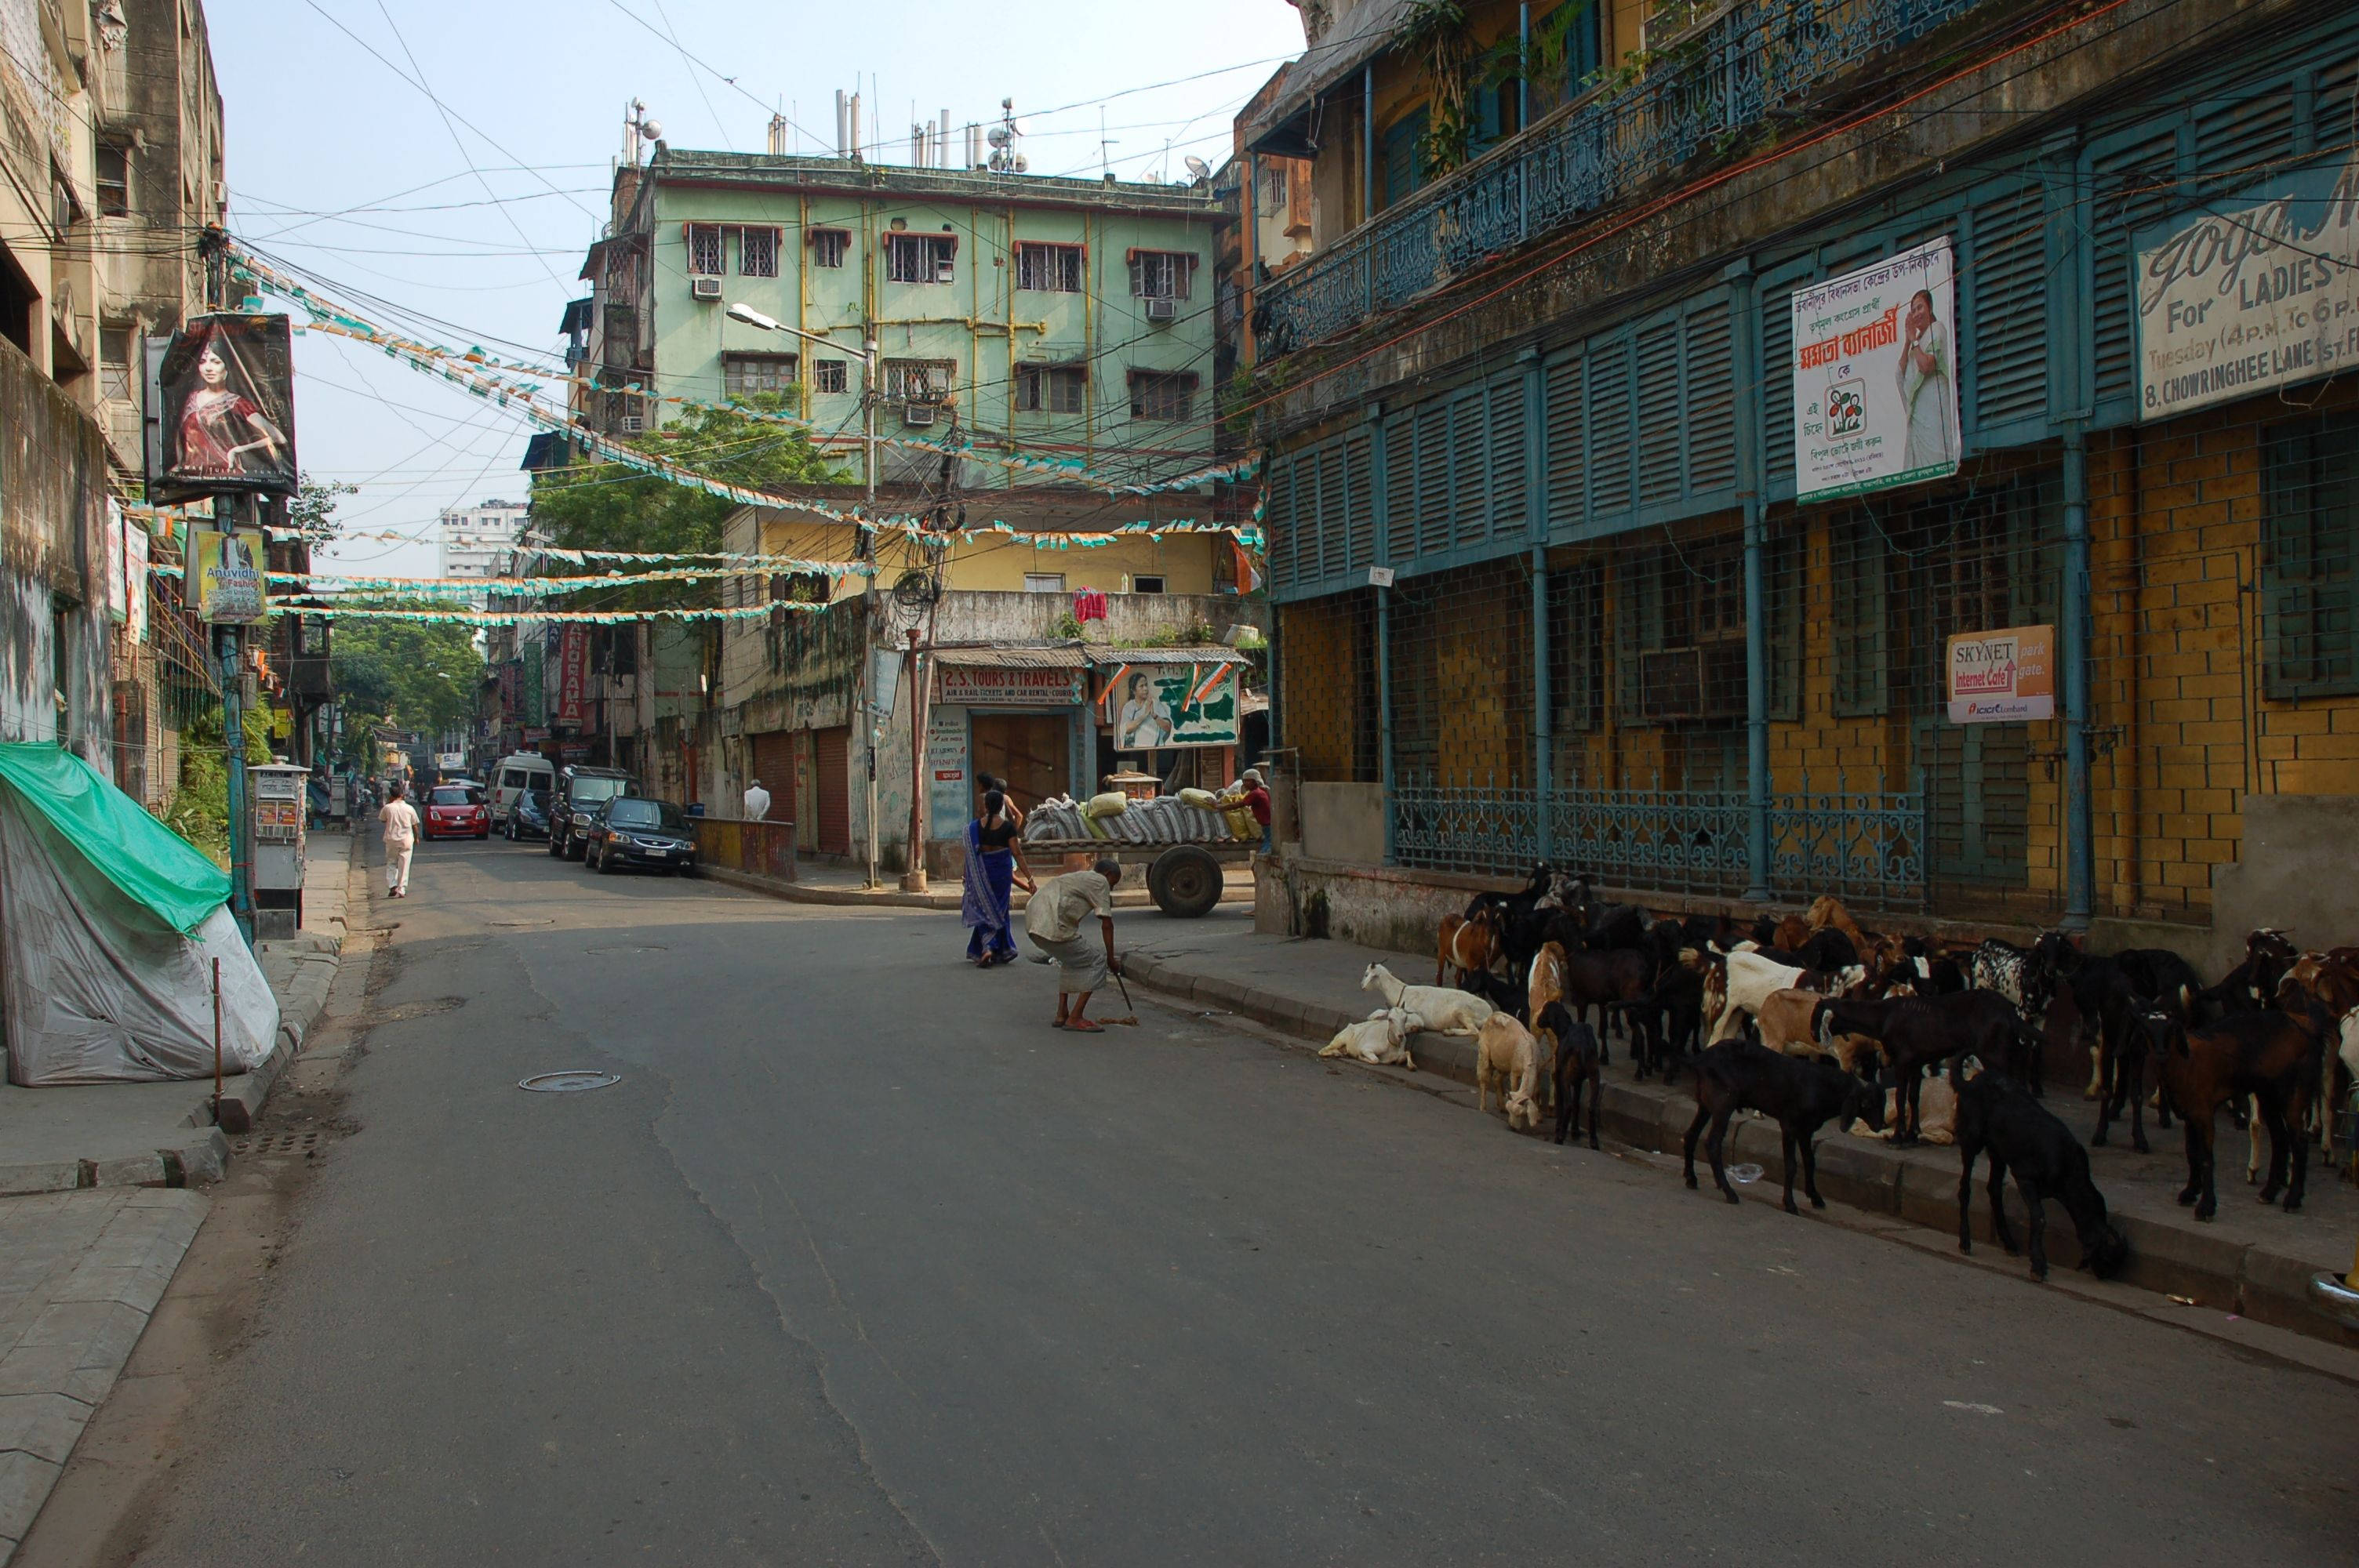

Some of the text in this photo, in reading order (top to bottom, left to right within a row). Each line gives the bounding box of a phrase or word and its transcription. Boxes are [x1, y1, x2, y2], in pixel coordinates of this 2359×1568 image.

[2168, 298, 2214, 334] For
[2239, 252, 2332, 311] LADIES
[1799, 336, 1841, 370] মমতা
[2149, 338, 2216, 372] Tuesday
[1837, 365, 1851, 379] কে
[2162, 351, 2268, 404] CHOWRINGHEE
[2272, 339, 2314, 375] LANE
[206, 567, 260, 579] Anuvidhi
[1956, 643, 2013, 663] SKYNET
[565, 623, 582, 717] ANORAMA
[972, 670, 1005, 687] TOURS
[1019, 672, 1070, 687] TRAVELS
[1956, 670, 1985, 688] Internet
